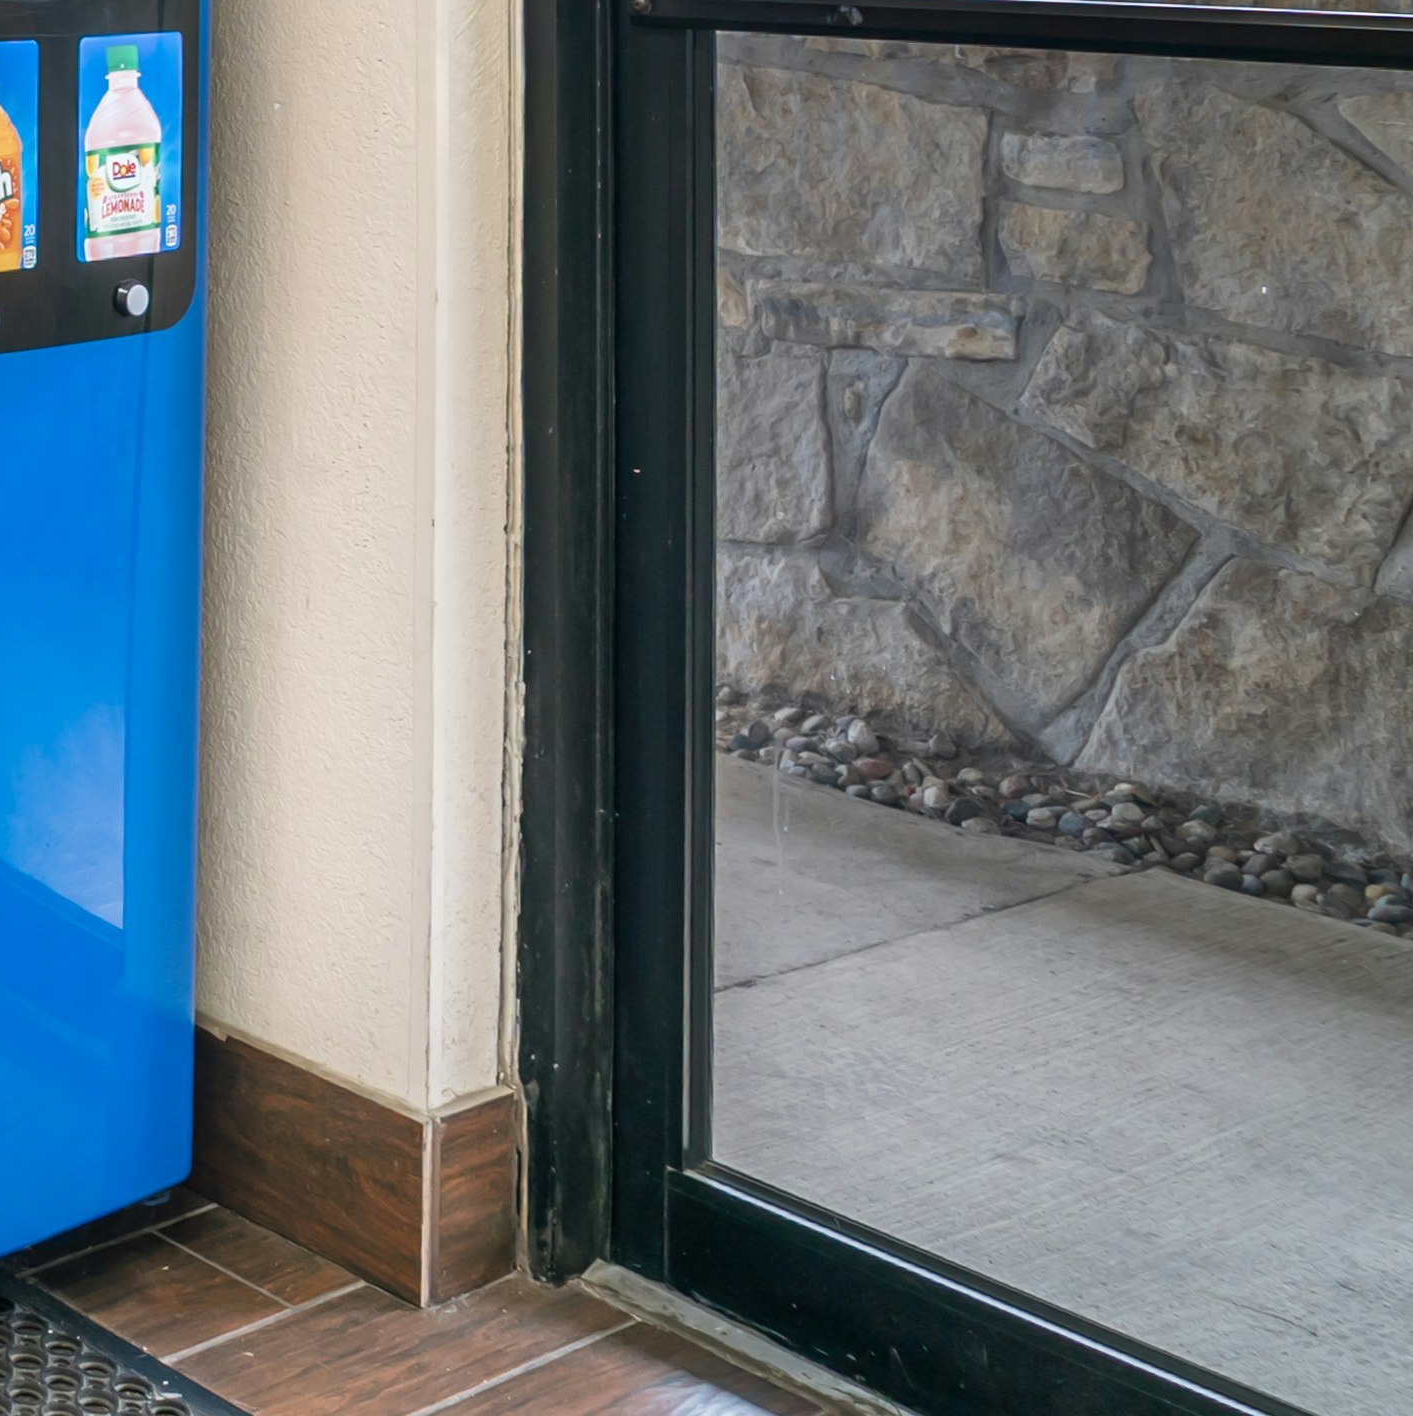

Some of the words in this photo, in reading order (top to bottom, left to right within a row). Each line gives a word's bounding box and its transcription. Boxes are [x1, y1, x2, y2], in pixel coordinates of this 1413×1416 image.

[113, 159, 136, 176] Dole
[102, 197, 145, 219] LEMONADE
[166, 204, 176, 216] 20
[24, 224, 36, 236] 20
